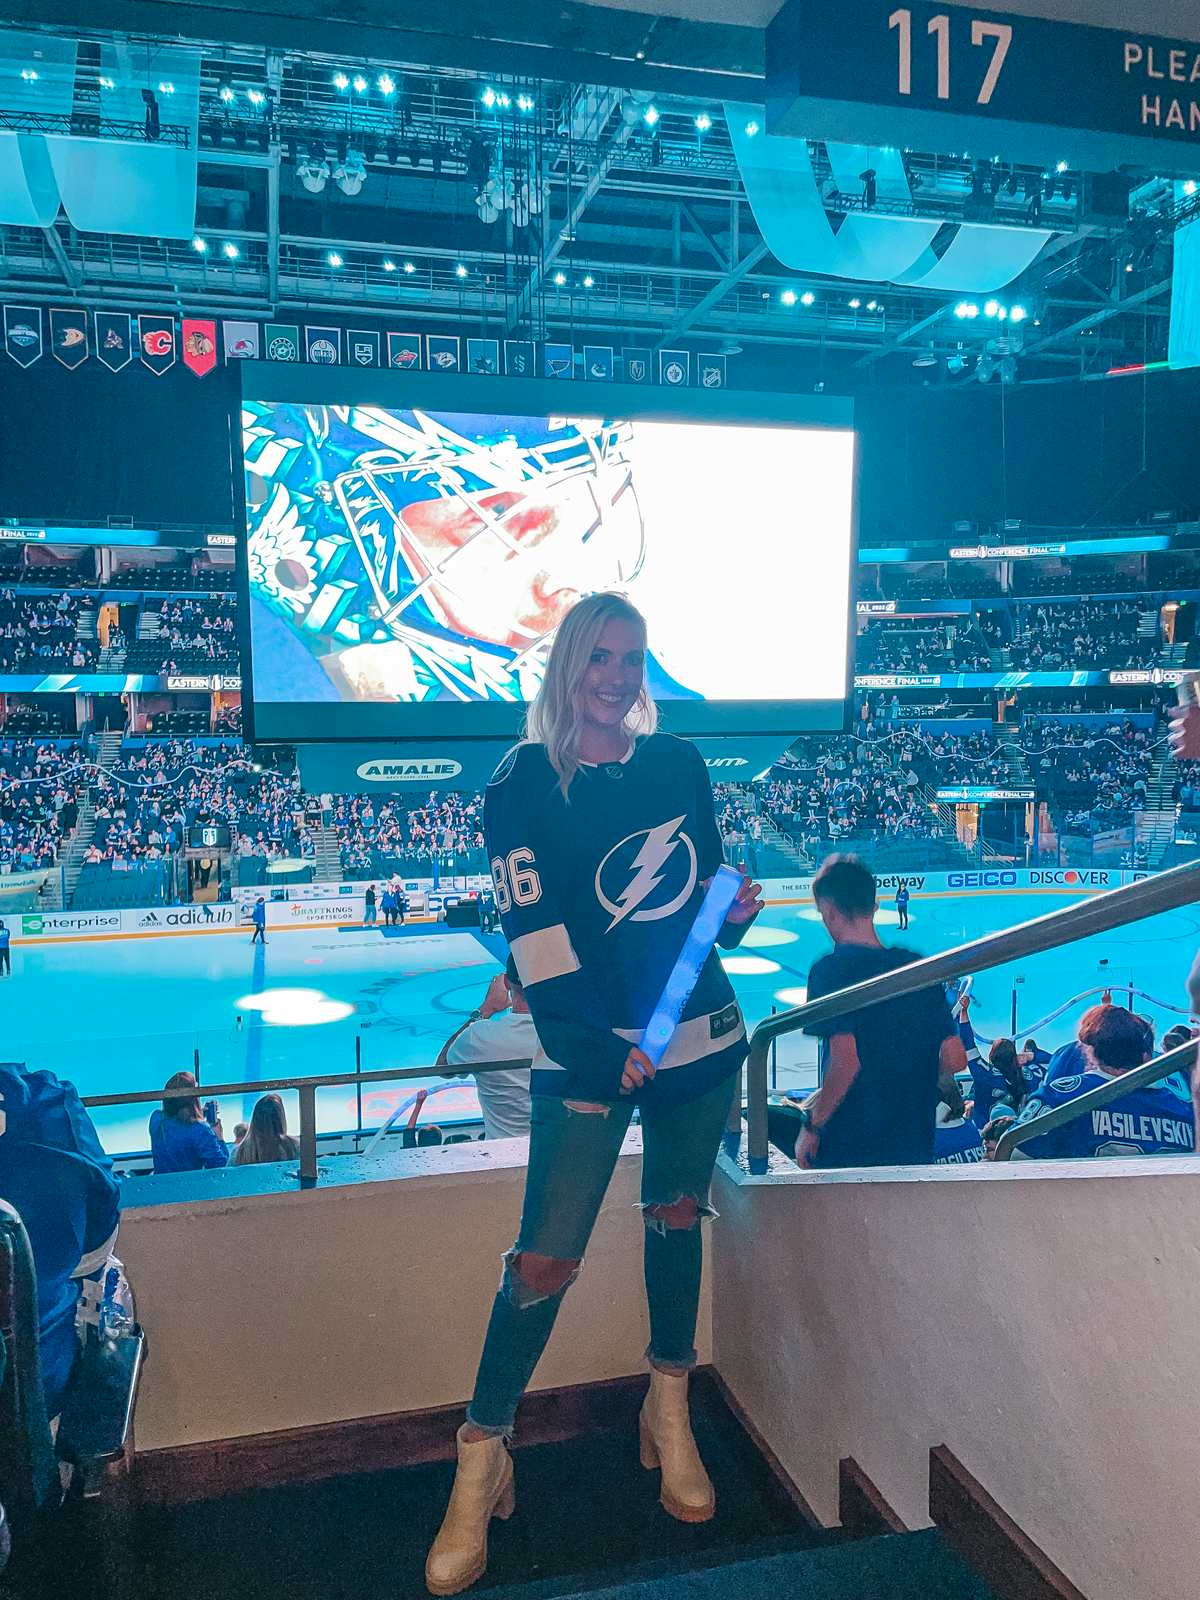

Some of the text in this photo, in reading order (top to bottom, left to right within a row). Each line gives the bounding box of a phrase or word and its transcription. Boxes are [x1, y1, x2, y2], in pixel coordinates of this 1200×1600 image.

[888, 8, 1012, 105] 117
[168, 679, 209, 688] EASTERN
[897, 677, 921, 686] FINAL
[1111, 672, 1150, 682] EASTERN
[365, 764, 455, 776] AMALIE
[491, 846, 543, 914] 86
[874, 874, 926, 890] betway
[947, 871, 1017, 888] GEICO
[1030, 871, 1109, 885] DISCOVER
[26, 914, 119, 931] enterprise
